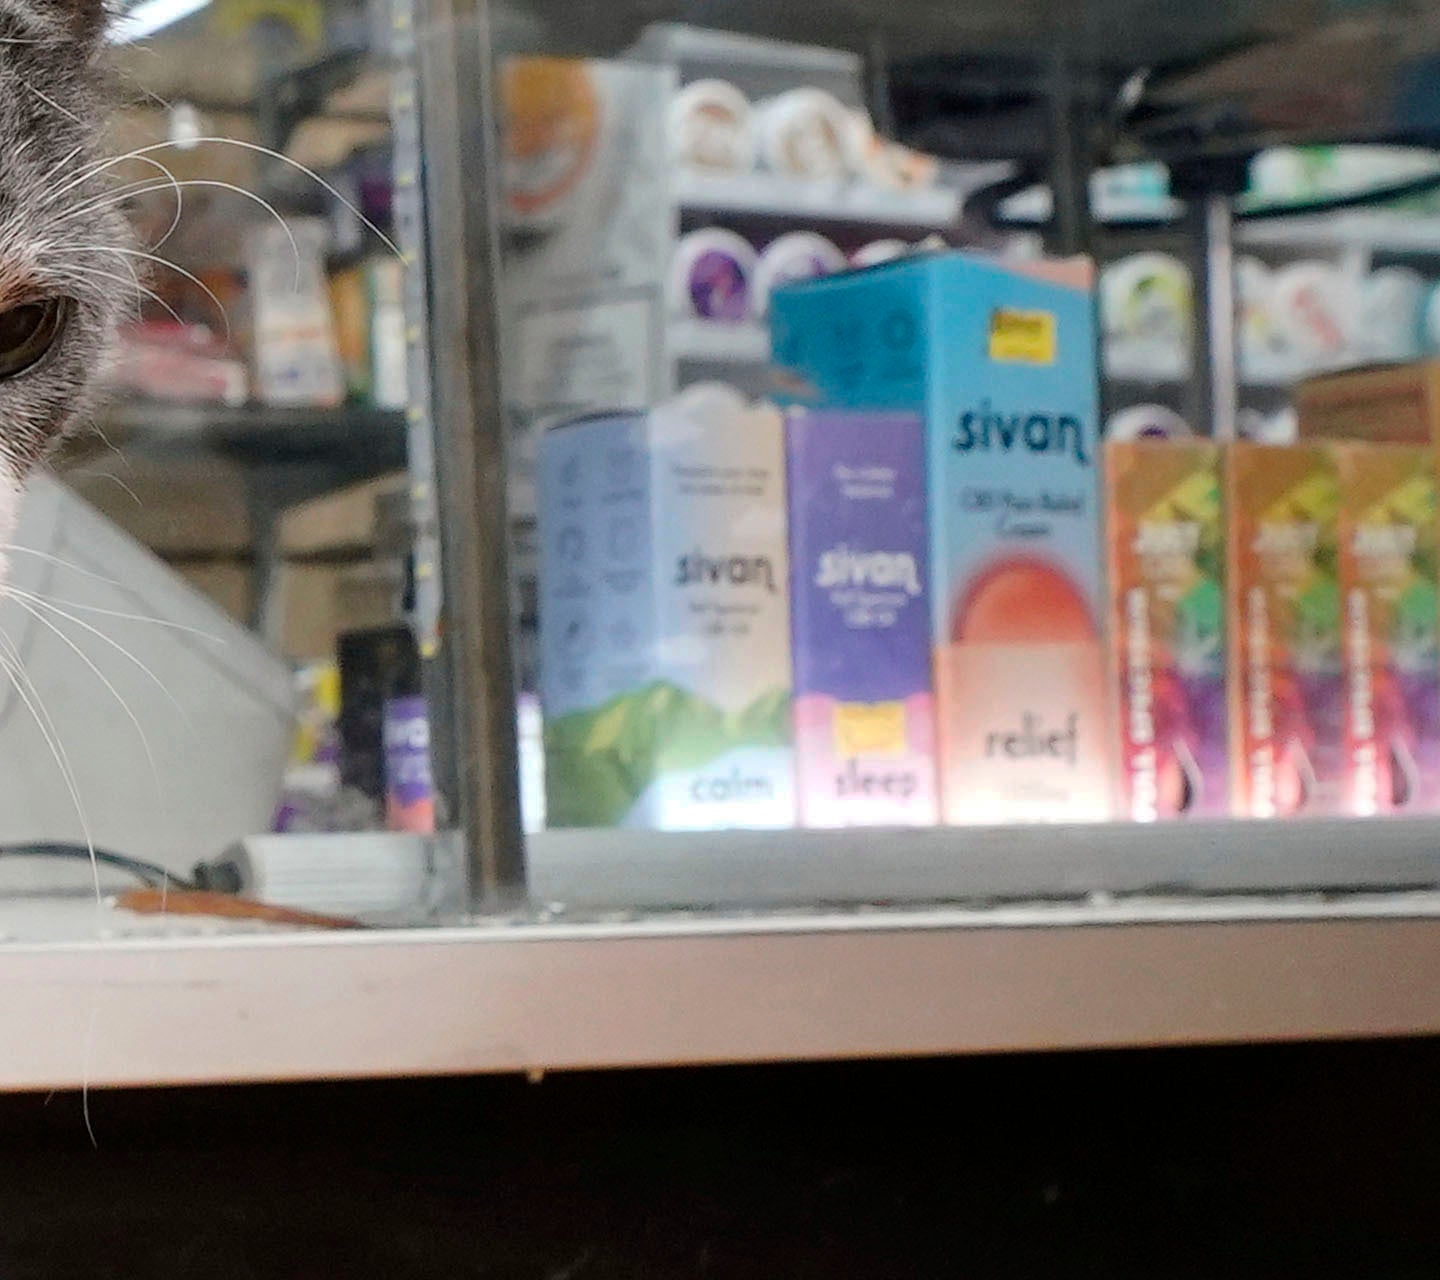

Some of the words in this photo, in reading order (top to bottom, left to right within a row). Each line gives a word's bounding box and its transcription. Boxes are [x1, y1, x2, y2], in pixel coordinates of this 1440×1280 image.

[951, 398, 1091, 468] sivan
[675, 544, 777, 594] sivan
[815, 542, 922, 596] sivan
[985, 710, 1078, 767] relief
[690, 767, 775, 802] calm
[834, 757, 919, 802] sleep
